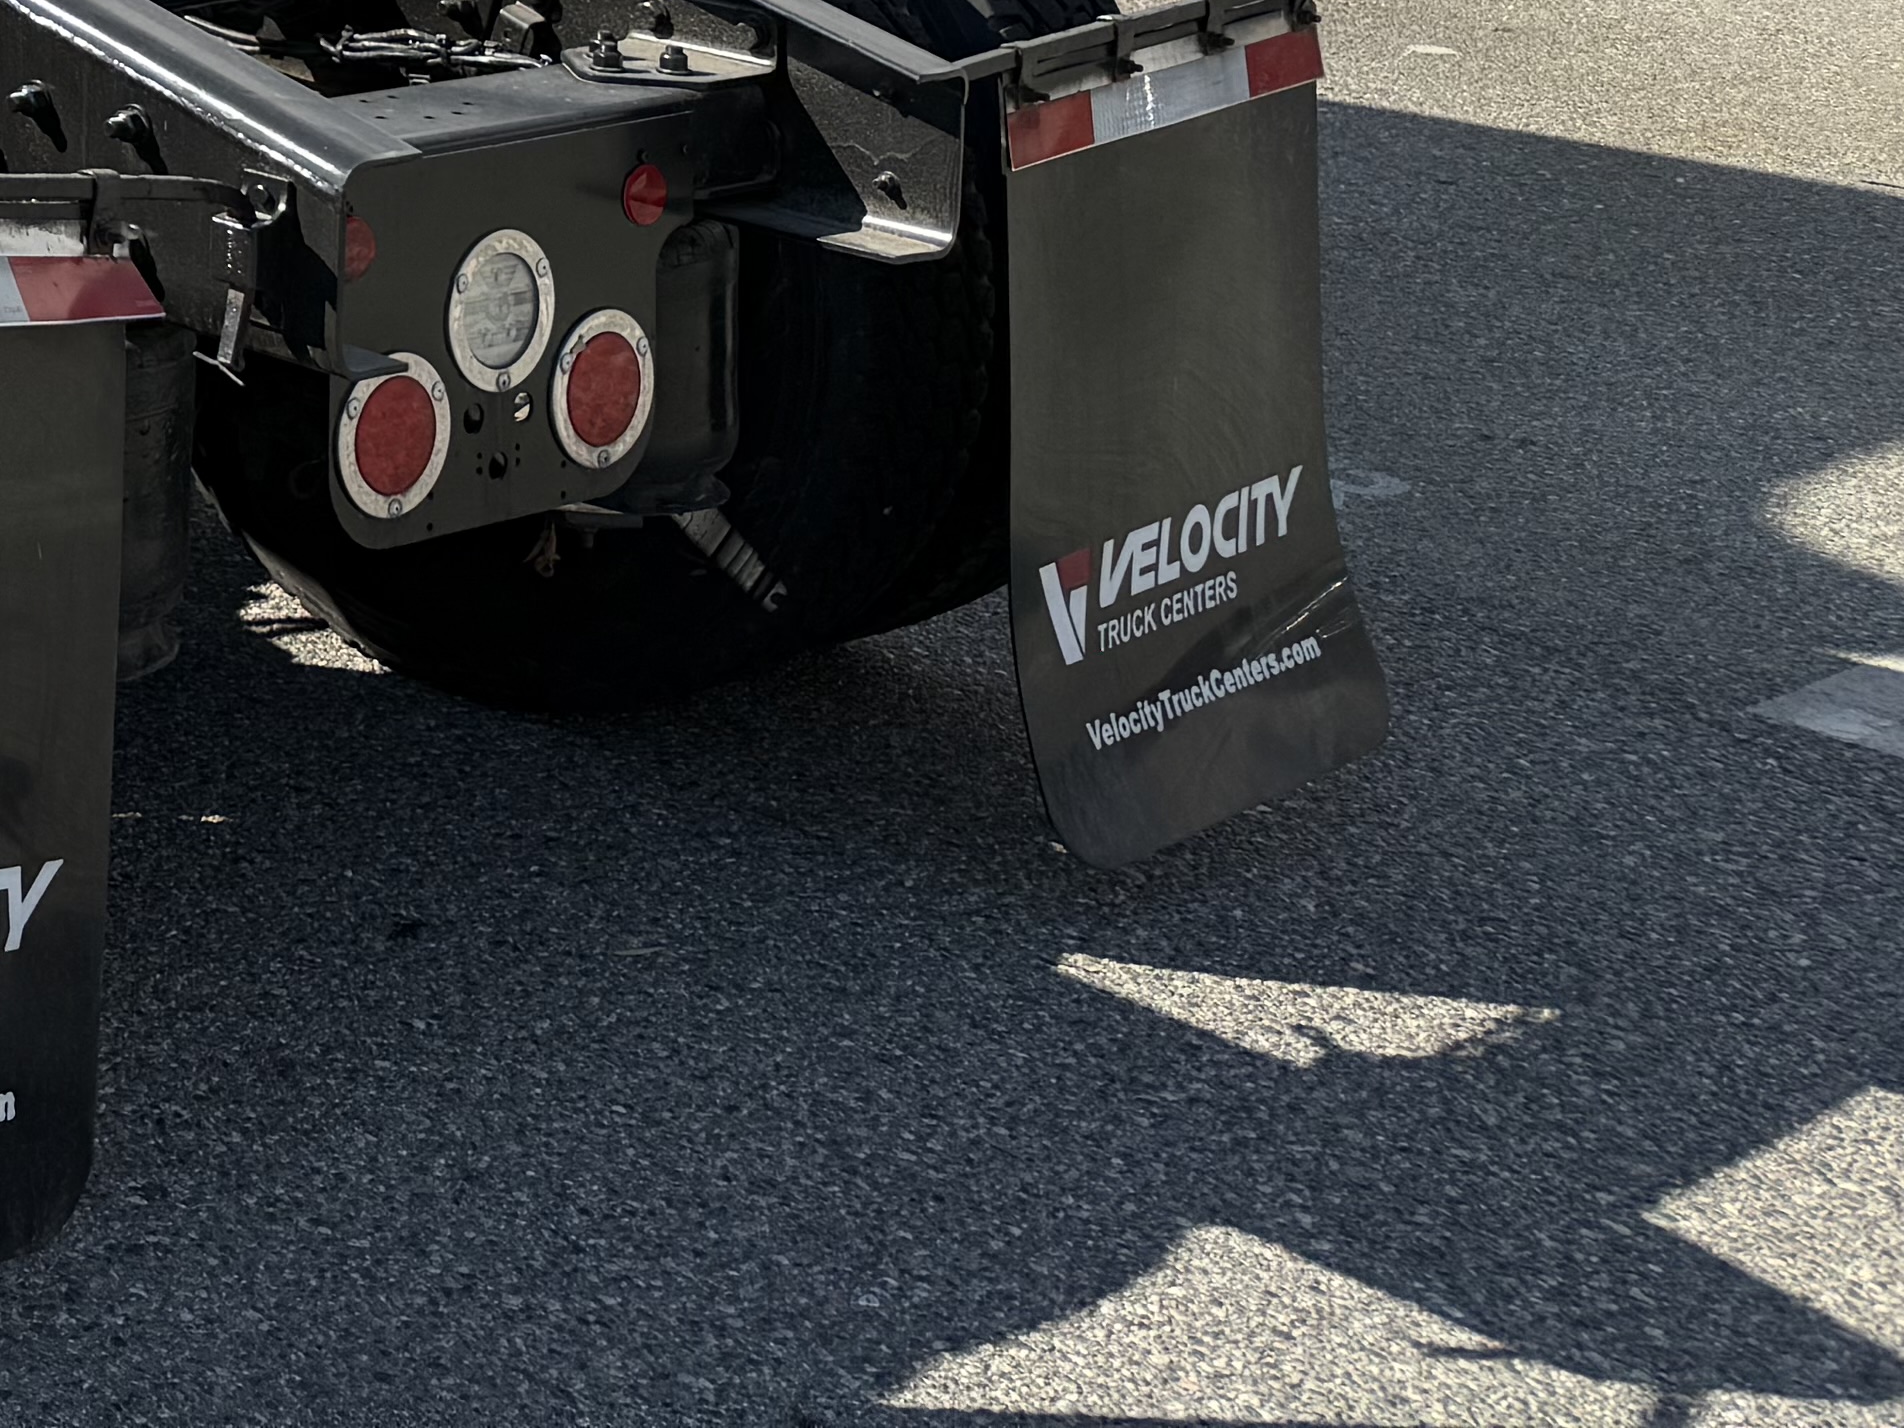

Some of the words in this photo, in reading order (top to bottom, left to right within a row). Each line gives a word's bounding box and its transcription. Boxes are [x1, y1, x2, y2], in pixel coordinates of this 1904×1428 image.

[1099, 465, 1303, 608] VELOCITY
[1098, 608, 1158, 652] TRUCK
[1160, 572, 1238, 627] CENTERS
[1086, 636, 1321, 750] VelocityTruckCenters.com
